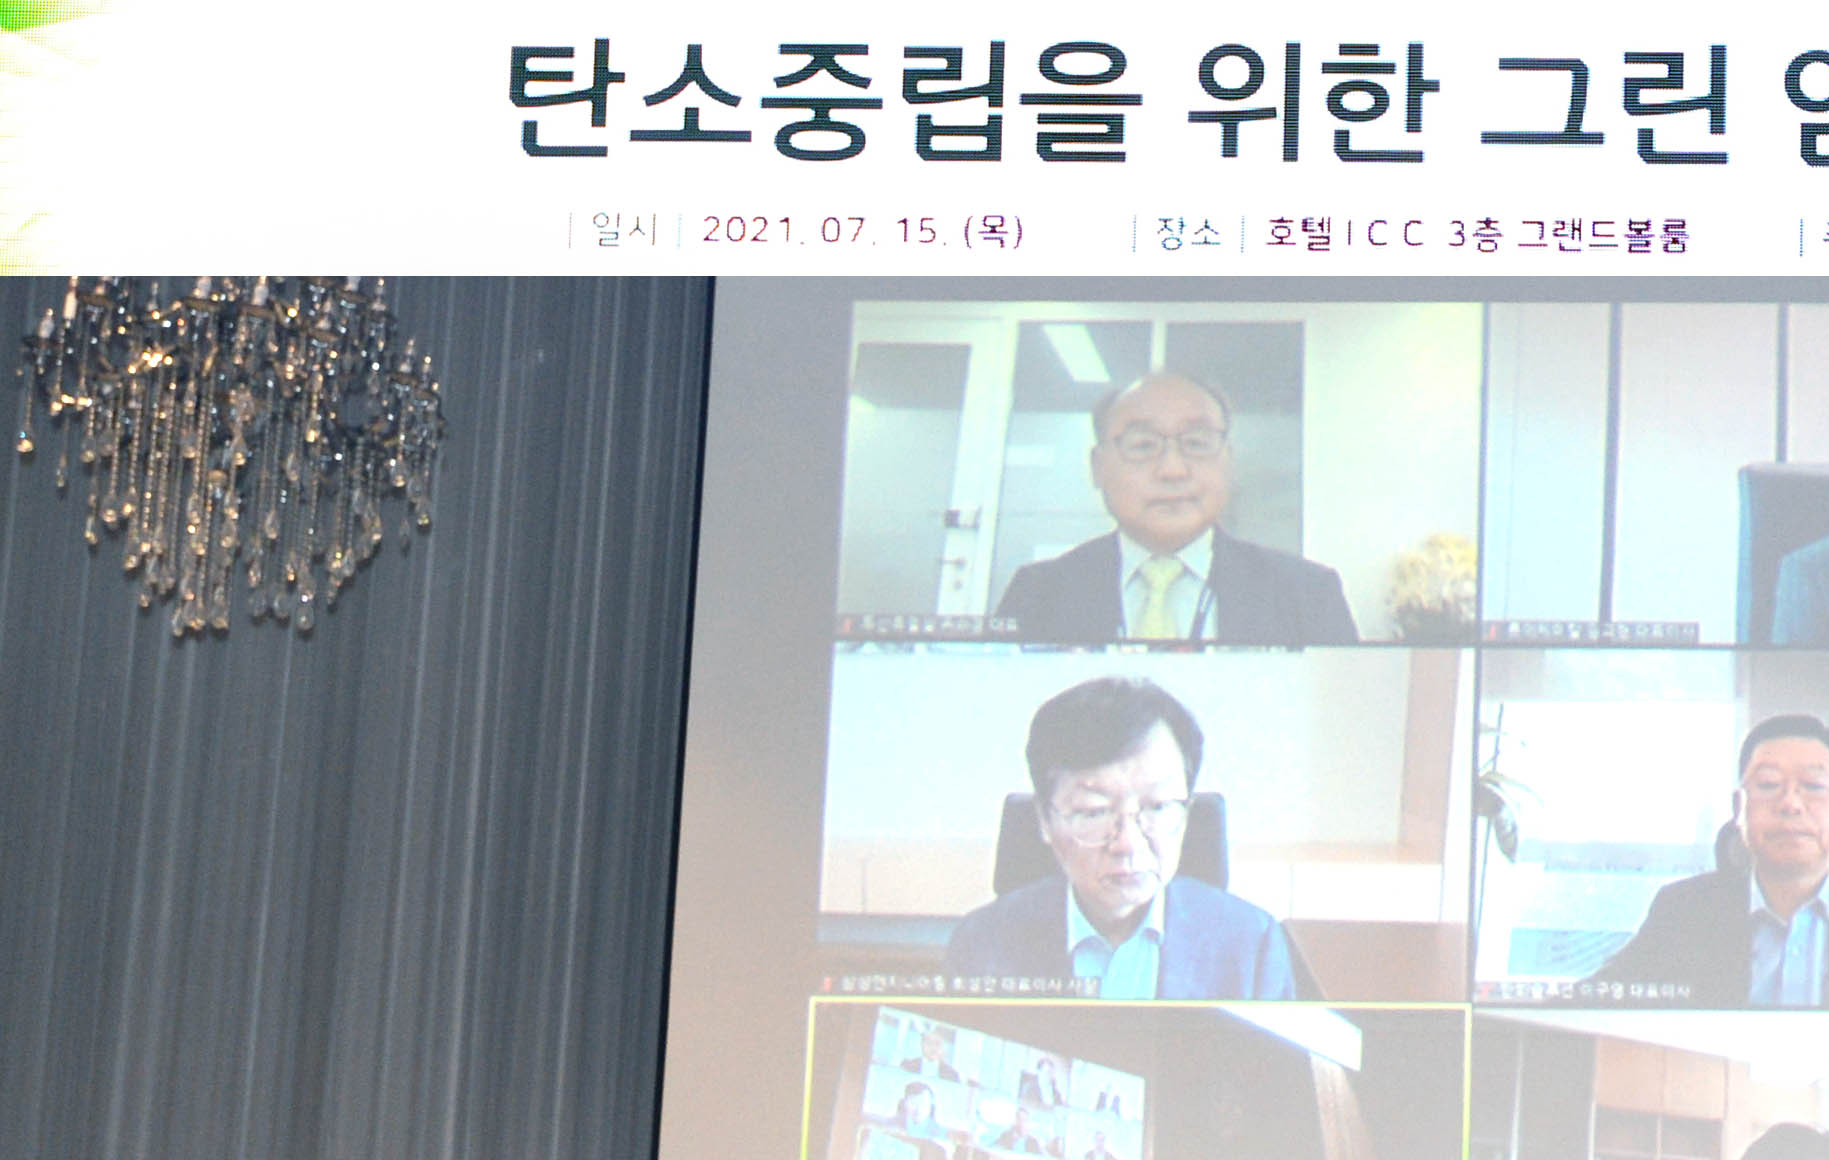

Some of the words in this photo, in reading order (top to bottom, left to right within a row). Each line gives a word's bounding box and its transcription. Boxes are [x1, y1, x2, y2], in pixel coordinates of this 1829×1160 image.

[510, 38, 1145, 164] 탄소중립을
[1188, 42, 1442, 165] 위한
[1481, 44, 1730, 166] 그린
[592, 212, 658, 249] 일시
[964, 215, 1024, 250] (목)
[1156, 217, 1223, 252] 장소
[1448, 217, 1506, 255] 3층
[1518, 217, 1692, 256] 그랜드볼룸
